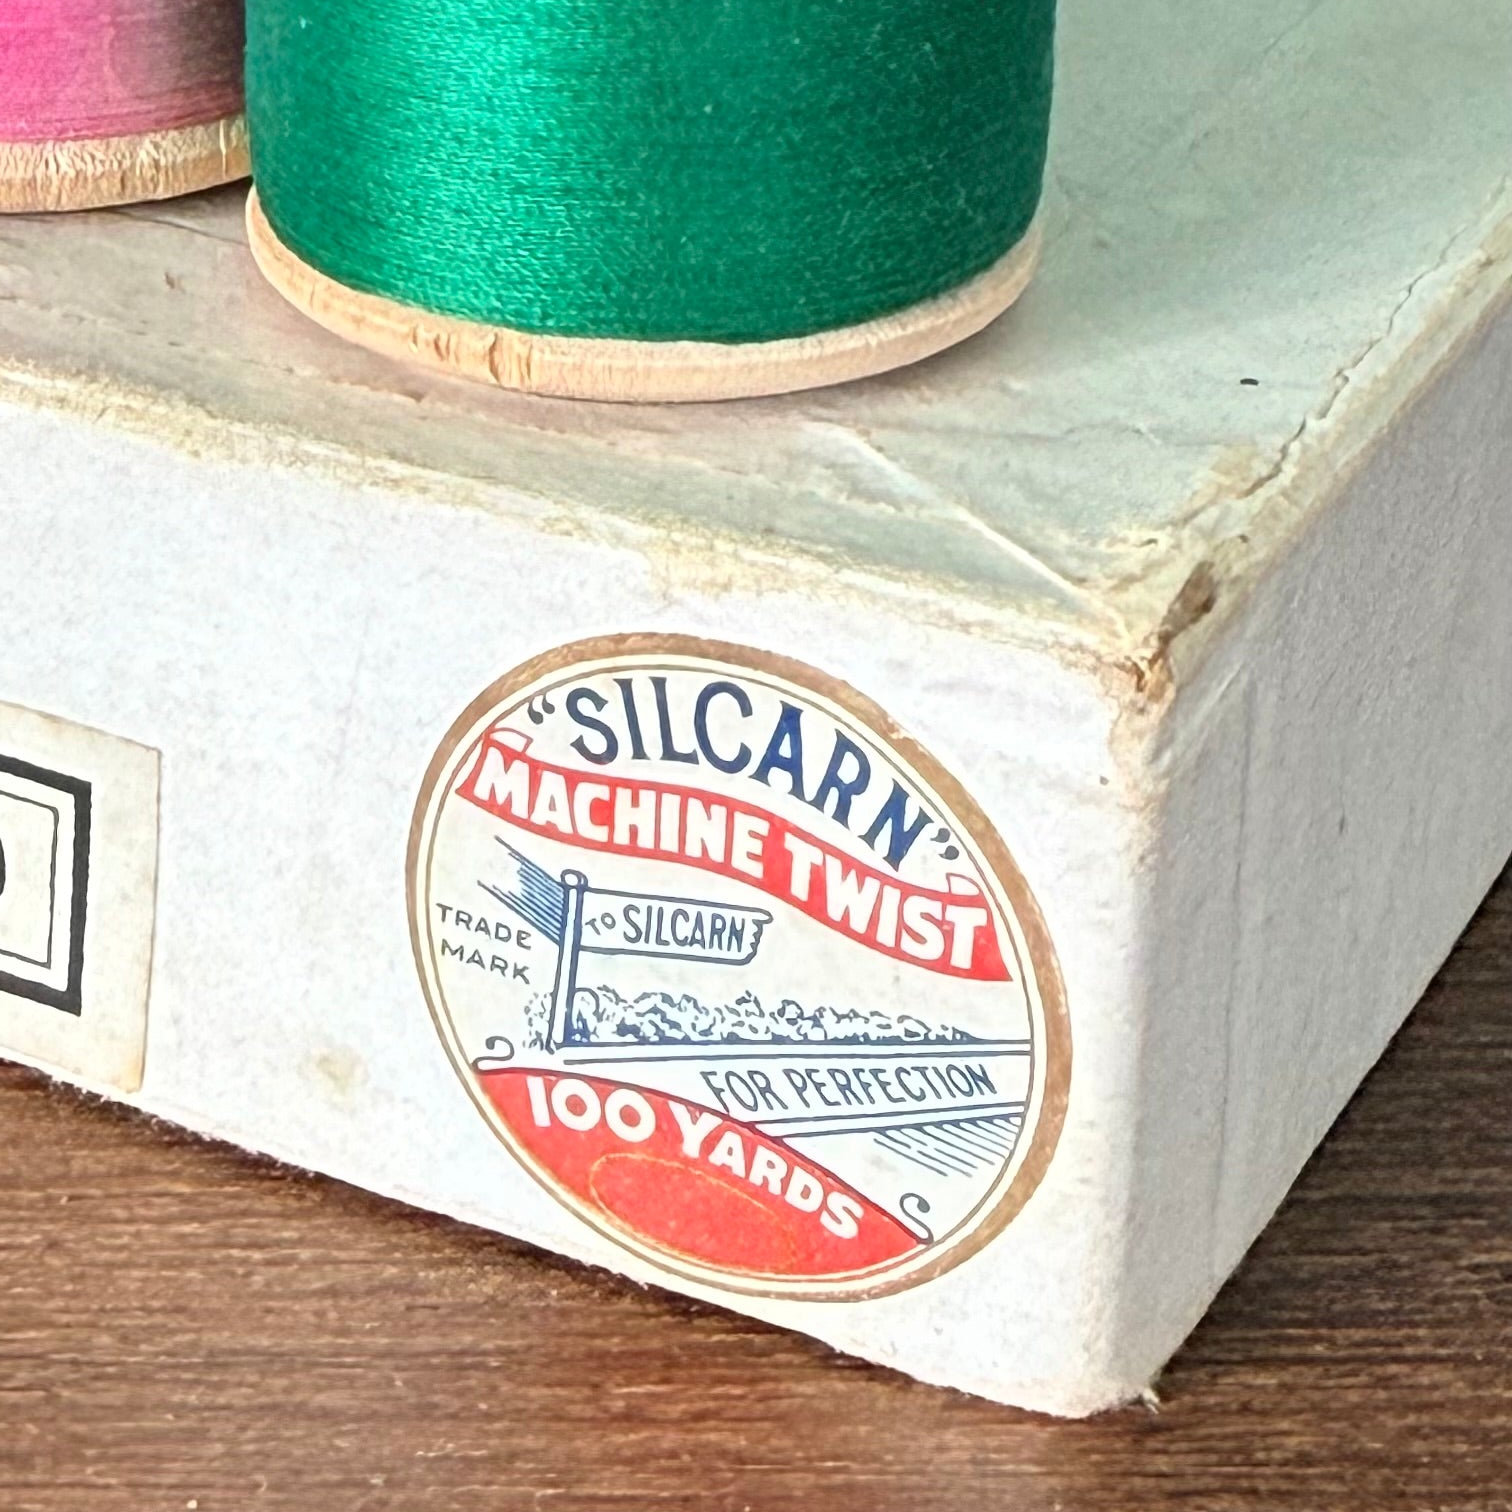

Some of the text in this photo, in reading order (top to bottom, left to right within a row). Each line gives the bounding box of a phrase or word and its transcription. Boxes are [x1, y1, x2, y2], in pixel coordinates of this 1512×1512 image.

[474, 746, 989, 971] MACHINE TWIST
[435, 902, 533, 950] TRADE
[586, 902, 746, 954] TO SILCARN
[439, 938, 532, 986] MARK
[700, 1063, 999, 1115] FOR PERFECTION
[525, 1074, 865, 1241] 100 YARDS
